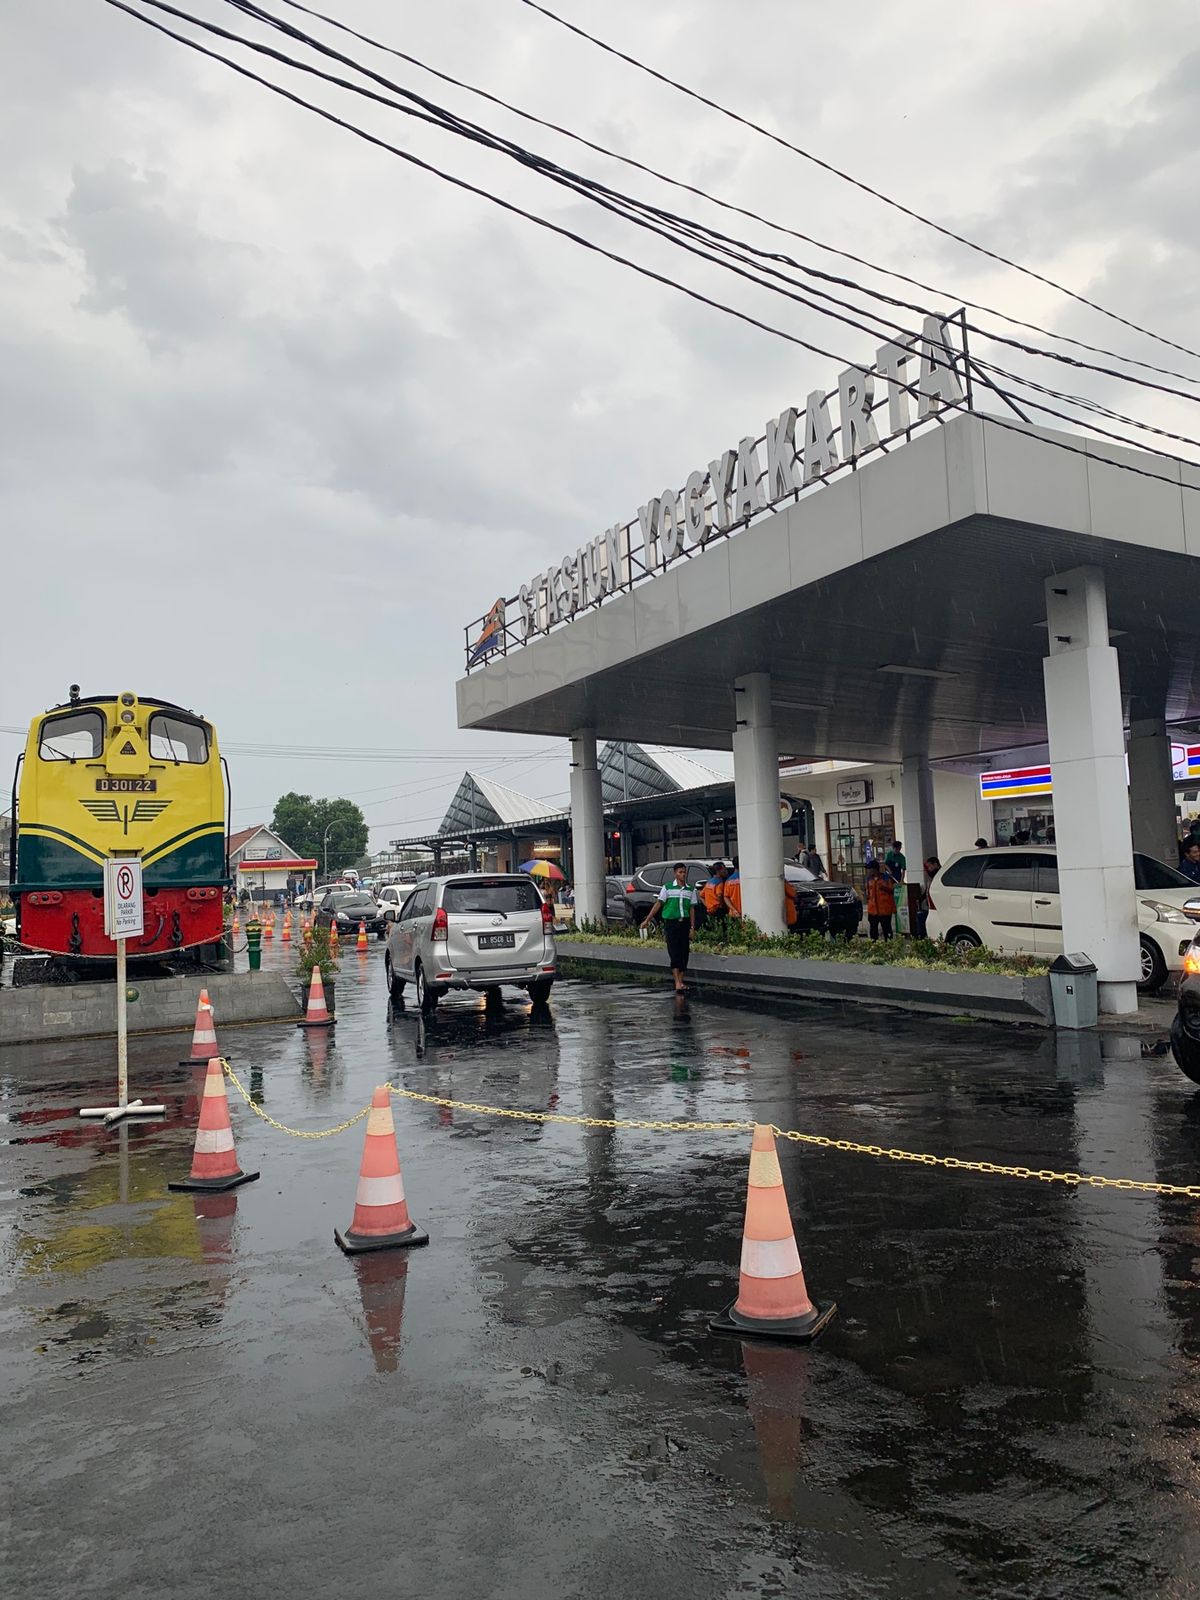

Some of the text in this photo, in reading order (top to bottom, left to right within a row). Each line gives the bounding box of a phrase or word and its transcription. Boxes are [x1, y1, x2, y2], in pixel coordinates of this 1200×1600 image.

[519, 311, 964, 637] STASIUN YOGYAKARTA
[101, 780, 109, 791] D
